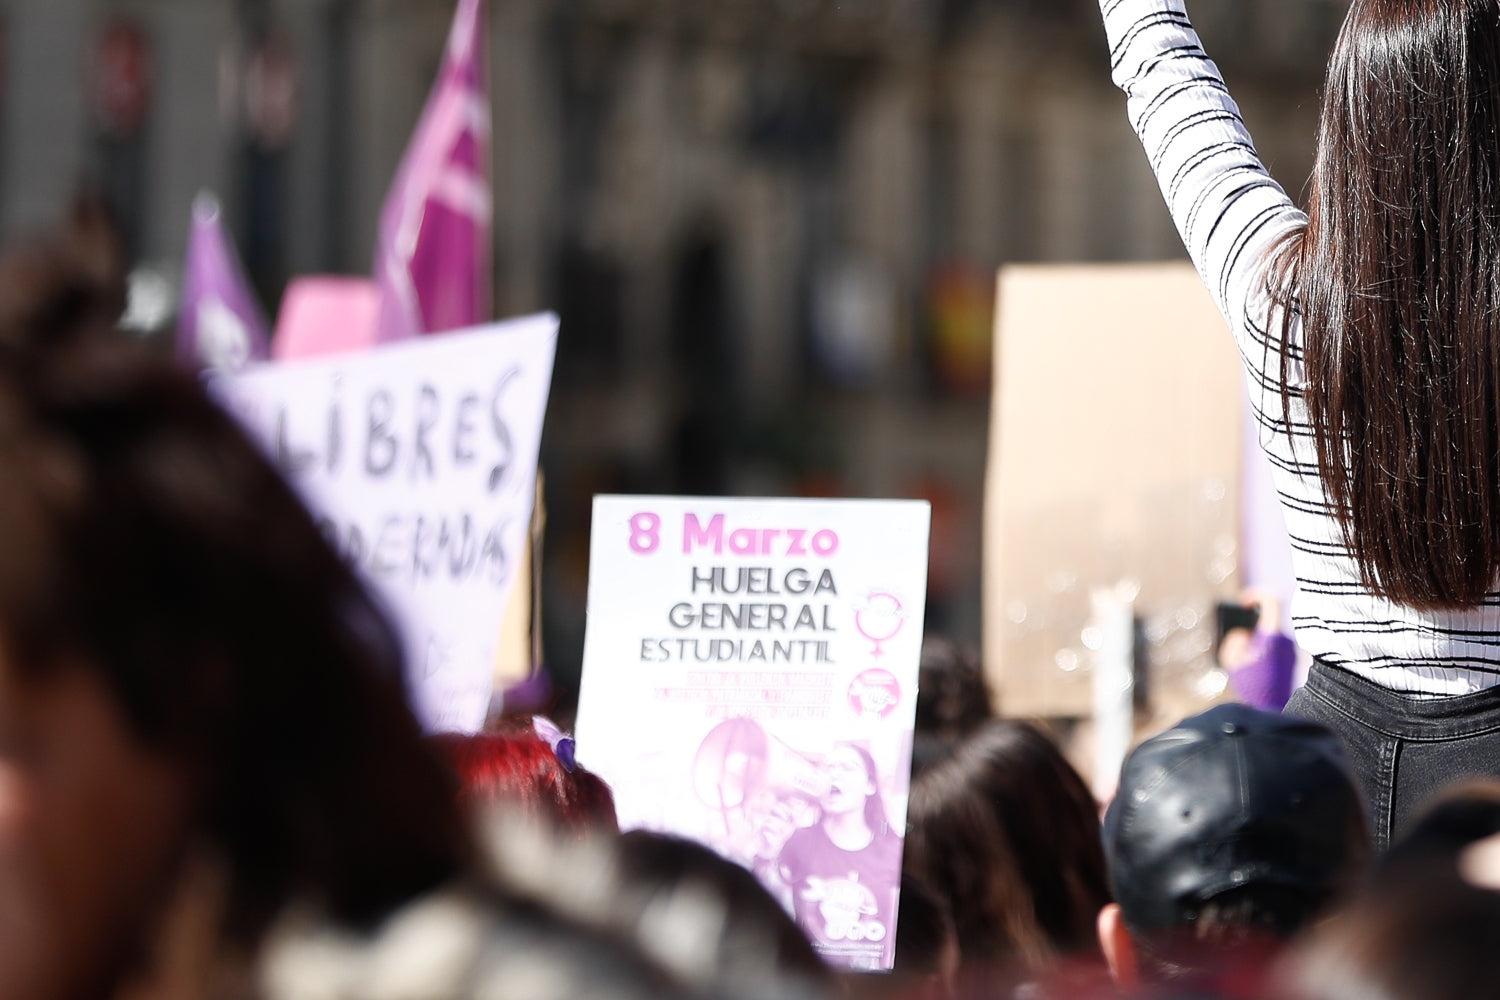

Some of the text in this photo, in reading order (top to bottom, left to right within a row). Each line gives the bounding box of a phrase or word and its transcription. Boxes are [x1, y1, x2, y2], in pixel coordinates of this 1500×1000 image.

[628, 512, 841, 557] 8 Marzo
[690, 566, 839, 597] HUELGA
[669, 602, 837, 633] GENERAL
[640, 638, 837, 664] ESTUDIANTIL
